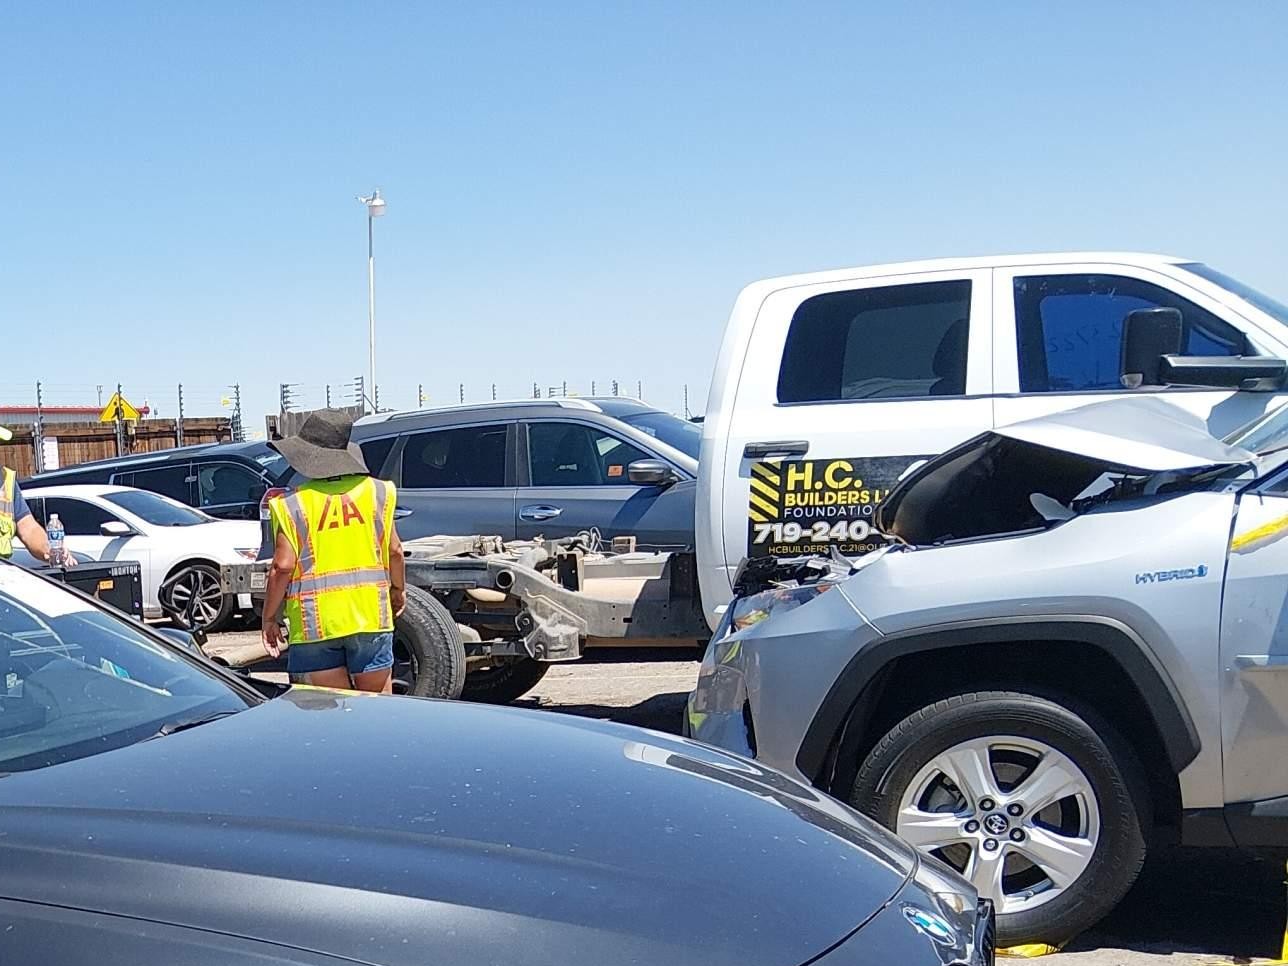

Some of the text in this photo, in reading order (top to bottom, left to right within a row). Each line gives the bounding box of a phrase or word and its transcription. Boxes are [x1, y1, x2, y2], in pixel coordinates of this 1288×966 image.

[786, 460, 863, 491] H.C.
[784, 490, 870, 507] BUILDERS
[1135, 568, 1195, 584] HYBRID
